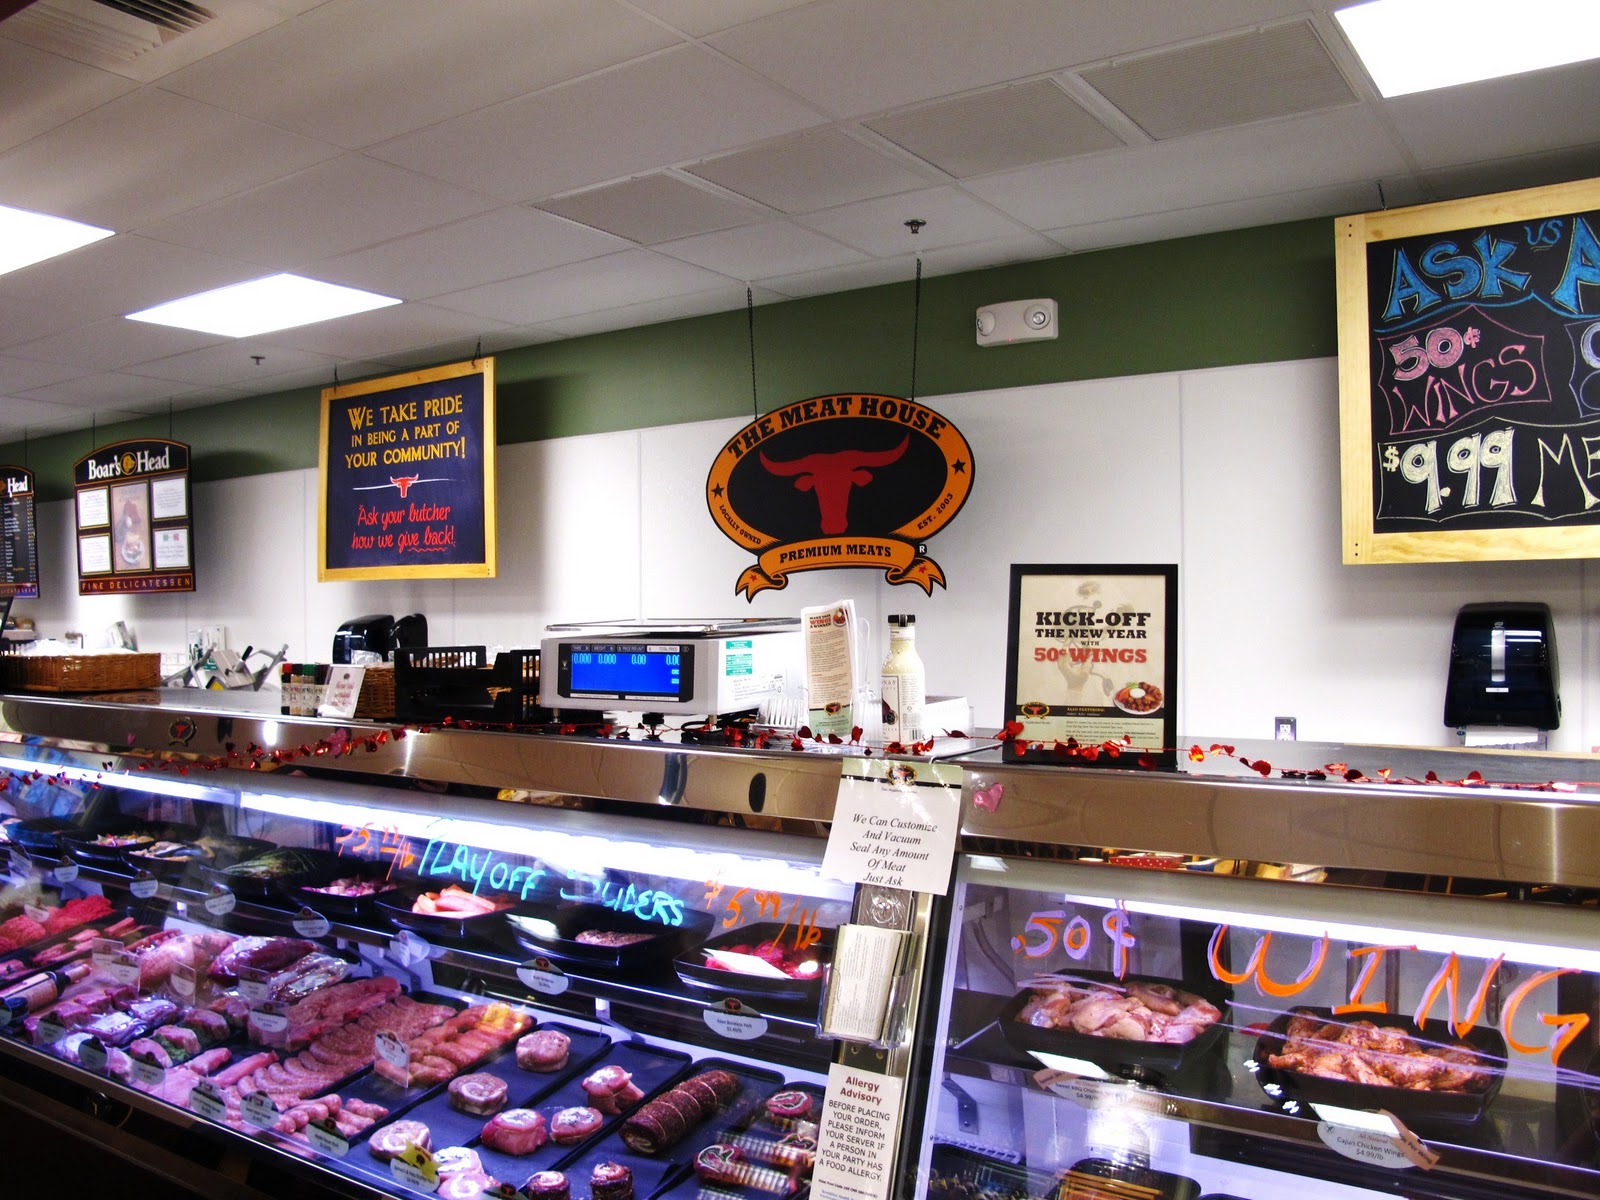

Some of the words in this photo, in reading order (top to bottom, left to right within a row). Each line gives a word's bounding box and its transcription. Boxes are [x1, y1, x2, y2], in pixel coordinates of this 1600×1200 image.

[1382, 230, 1531, 322] ASK
[1524, 219, 1563, 246] US
[1392, 344, 1537, 431] WINGS
[347, 406, 373, 430] WE
[380, 402, 417, 424] TAKE
[424, 394, 463, 418] PRIDE
[351, 434, 362, 448] IN
[367, 429, 397, 445] BEING
[402, 429, 409, 441] A
[414, 423, 441, 439] PART
[446, 421, 460, 435] OF
[727, 418, 775, 459] THE
[780, 397, 852, 430] MEAT
[859, 397, 947, 440] HOUSE
[345, 452, 377, 469] YOUR
[383, 436, 466, 465] COMMUNITY!
[88, 455, 121, 480] Boar's
[136, 447, 170, 472] Head
[1383, 427, 1517, 514] $9.99
[7, 475, 28, 495] Head
[357, 504, 378, 526] Ask
[381, 511, 404, 531] your
[408, 503, 451, 523] butcher
[719, 504, 740, 531] LOCALLY
[917, 515, 936, 530] EST.
[936, 493, 953, 514] 2003
[351, 533, 375, 549] how
[378, 535, 394, 547] we
[398, 531, 419, 553] give
[423, 525, 456, 546] back!
[739, 529, 762, 545] OWNED
[779, 544, 842, 564] PREMIUM
[846, 544, 892, 557] MEATS
[82, 582, 104, 590] FINE
[110, 578, 191, 590] DELICATESSEN
[1036, 612, 1151, 626] KICK-OFF
[1035, 629, 1064, 638] THE
[1069, 630, 1103, 638] NEW
[1107, 630, 1147, 639] YEAR
[1069, 648, 1147, 663] WINGS
[852, 813, 867, 824] We
[869, 815, 888, 826] Can
[890, 818, 938, 832] Customize
[862, 830, 881, 840] And
[884, 831, 921, 845] Vacuum
[850, 842, 870, 852] Seal
[872, 844, 891, 857] Any
[892, 847, 930, 861] Amount
[867, 858, 879, 870] Of
[881, 860, 906, 872] Meat
[863, 872, 884, 883] Just
[884, 874, 903, 886] Ask
[1206, 923, 1590, 1065] WING
[845, 1076, 880, 1093] Allergy
[840, 1087, 882, 1106] Advisory
[828, 1099, 856, 1113] BEFORE
[858, 1107, 890, 1121] PLACING
[827, 1120, 854, 1133] PLEASE
[855, 1127, 885, 1140] INFORM
[833, 1111, 852, 1122] YOUR
[854, 1115, 882, 1130] ORDER,
[825, 1129, 844, 1141] YOUR
[846, 1135, 875, 1149] SERVER
[877, 1142, 885, 1151] IF
[1337, 1136, 1356, 1147] Cajun
[1356, 1141, 1382, 1152] Chicken
[1383, 1147, 1405, 1158] Wings
[822, 1149, 841, 1160] YOUR
[842, 1154, 866, 1166] PARTY
[867, 1162, 883, 1171] HAS
[836, 1143, 866, 1156] PERSON
[868, 1151, 877, 1159] IN
[826, 1161, 846, 1172] FOOD
[847, 1166, 882, 1181] ALLERGY.
